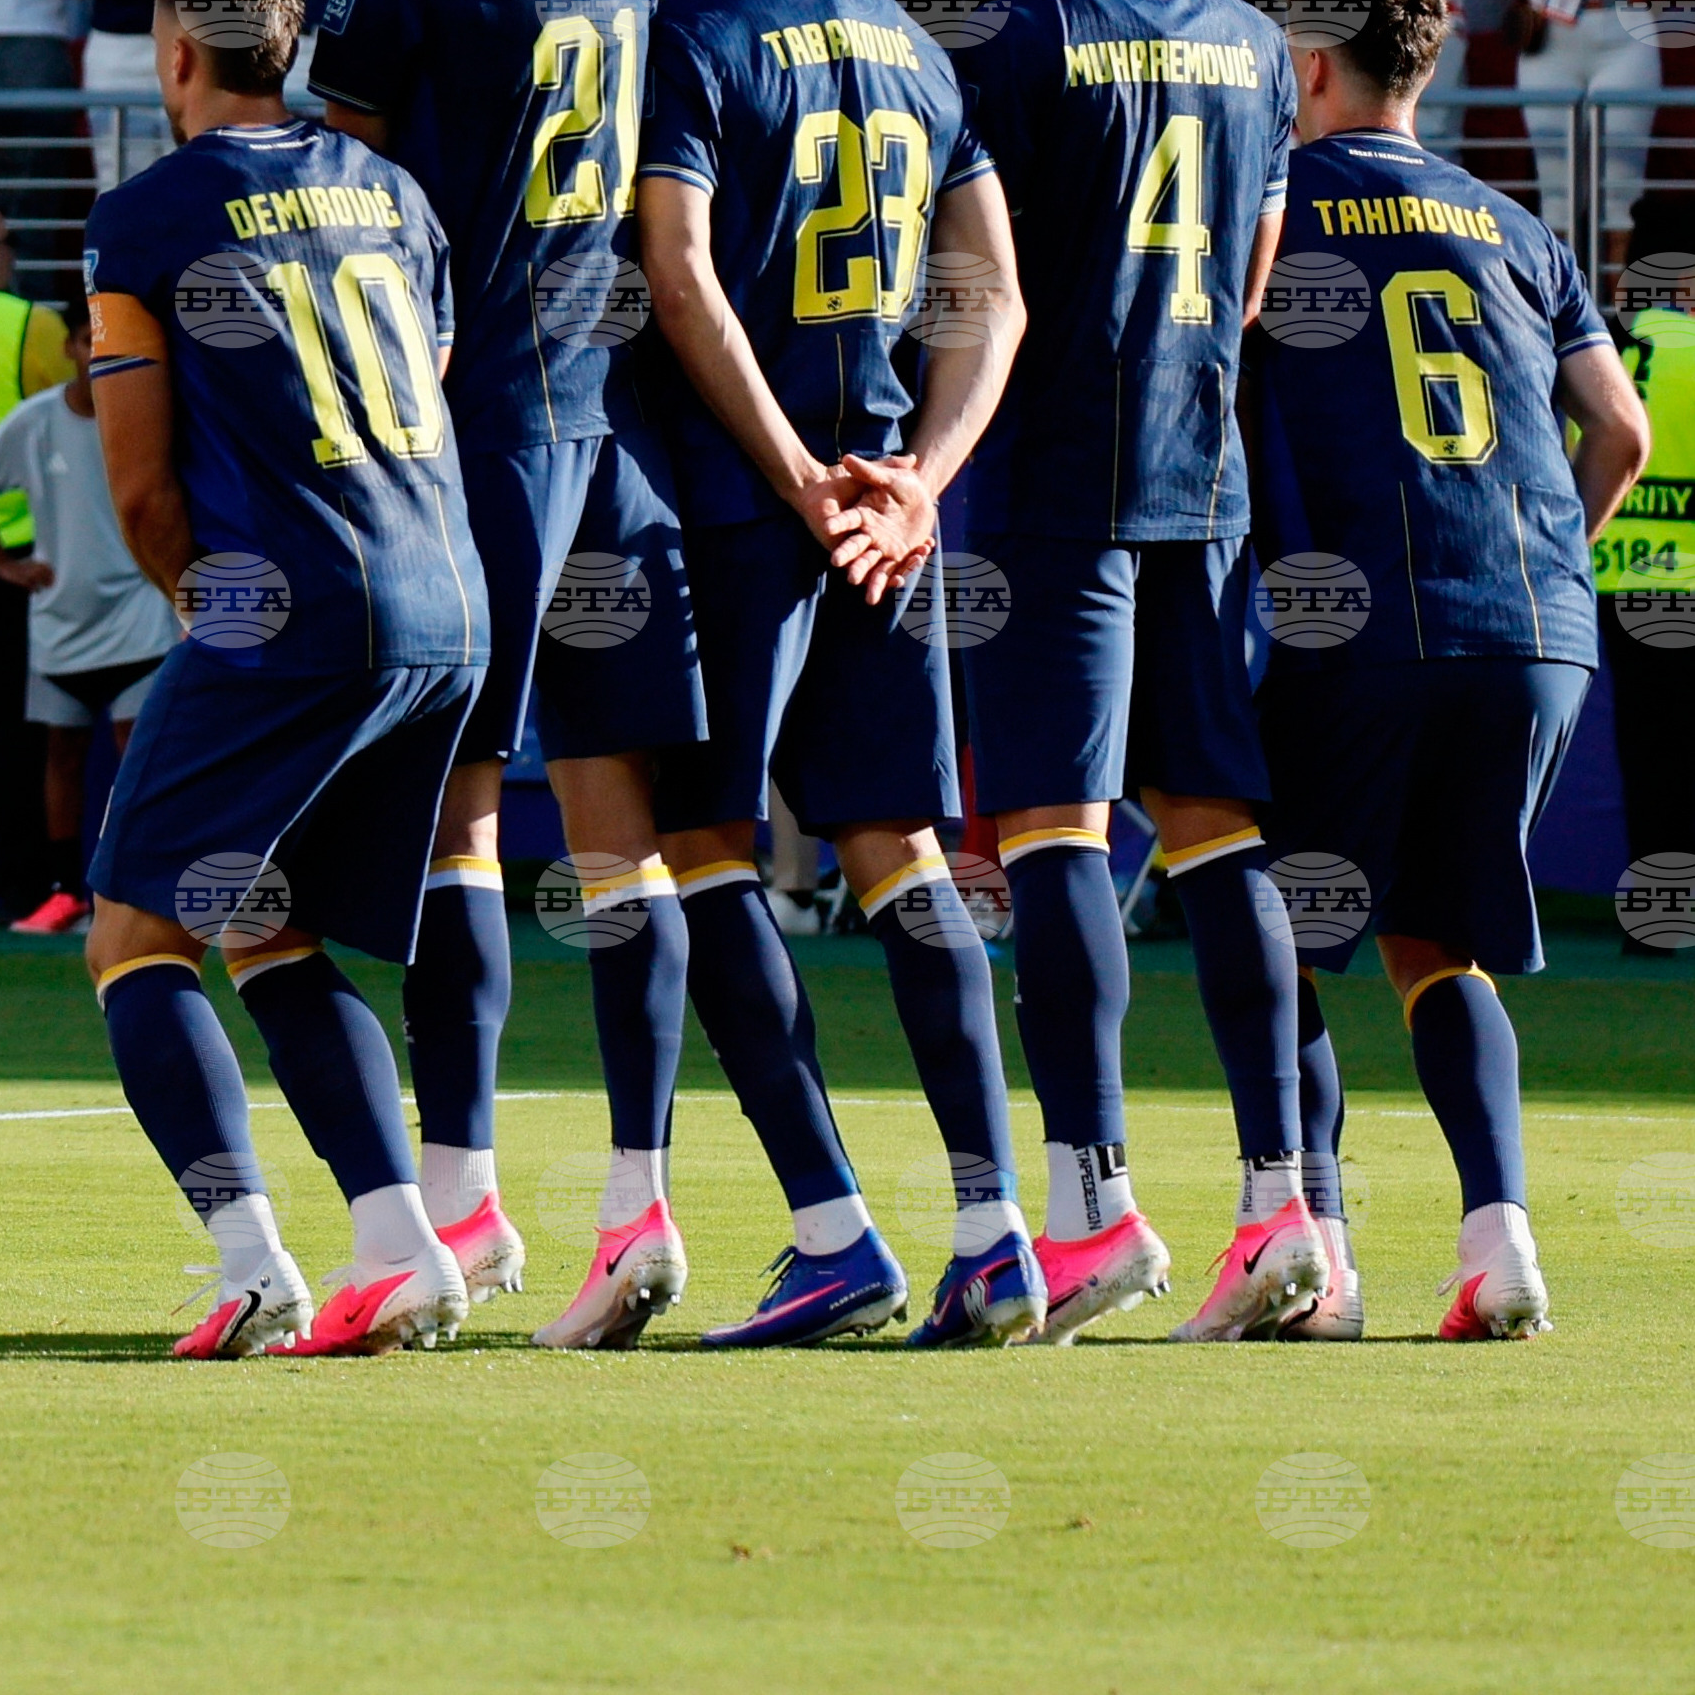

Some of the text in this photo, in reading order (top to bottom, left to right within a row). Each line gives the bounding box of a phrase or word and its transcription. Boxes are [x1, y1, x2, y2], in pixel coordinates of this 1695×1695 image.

[761, 18, 921, 71] TABAKOVIĆ
[1063, 39, 1259, 89] MUHAREMOVIĆ
[524, 7, 640, 227] 21
[224, 182, 402, 240] DEMIROVIĆ
[793, 110, 932, 324] 23
[1127, 114, 1212, 325] 4
[1312, 195, 1502, 245] TAHIROVIĆ
[265, 252, 445, 468] 10
[1380, 269, 1498, 465] 6
[1625, 486, 1692, 515] RITY
